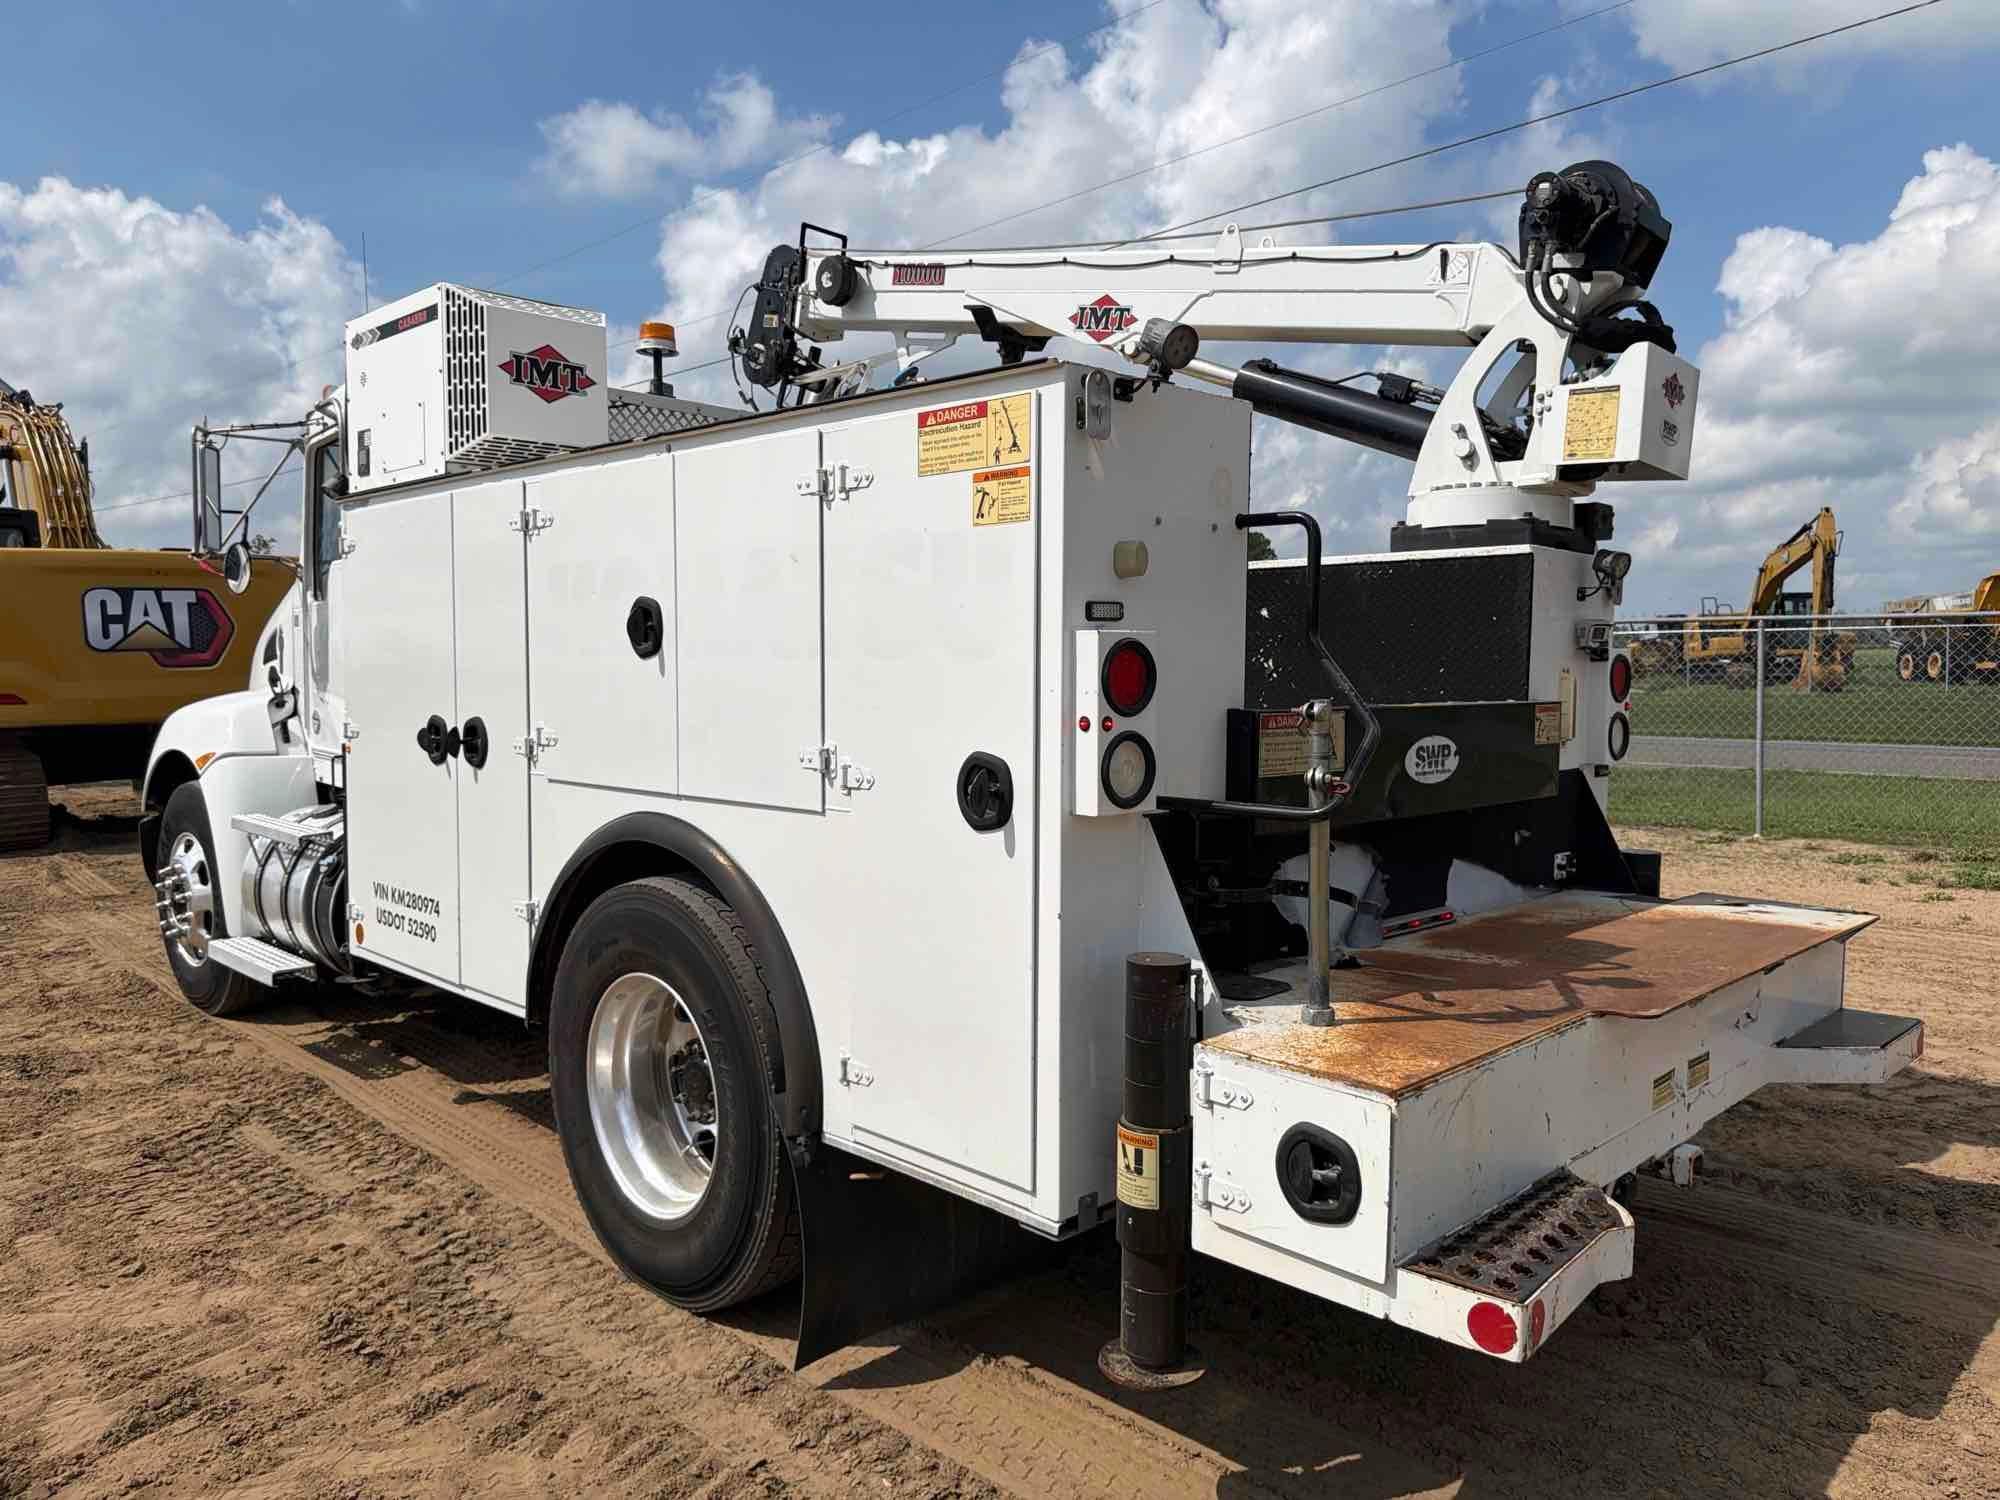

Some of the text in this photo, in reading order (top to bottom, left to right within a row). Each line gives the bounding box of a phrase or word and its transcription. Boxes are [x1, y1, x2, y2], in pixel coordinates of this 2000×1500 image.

[1075, 305, 1131, 331] IMT
[511, 352, 586, 393] IMT
[936, 405, 978, 422] DANGER
[84, 588, 197, 650] CAT
[1416, 744, 1451, 763] SWP
[373, 881, 440, 918] VIN KM280974
[376, 906, 437, 943] USDOT 52590
